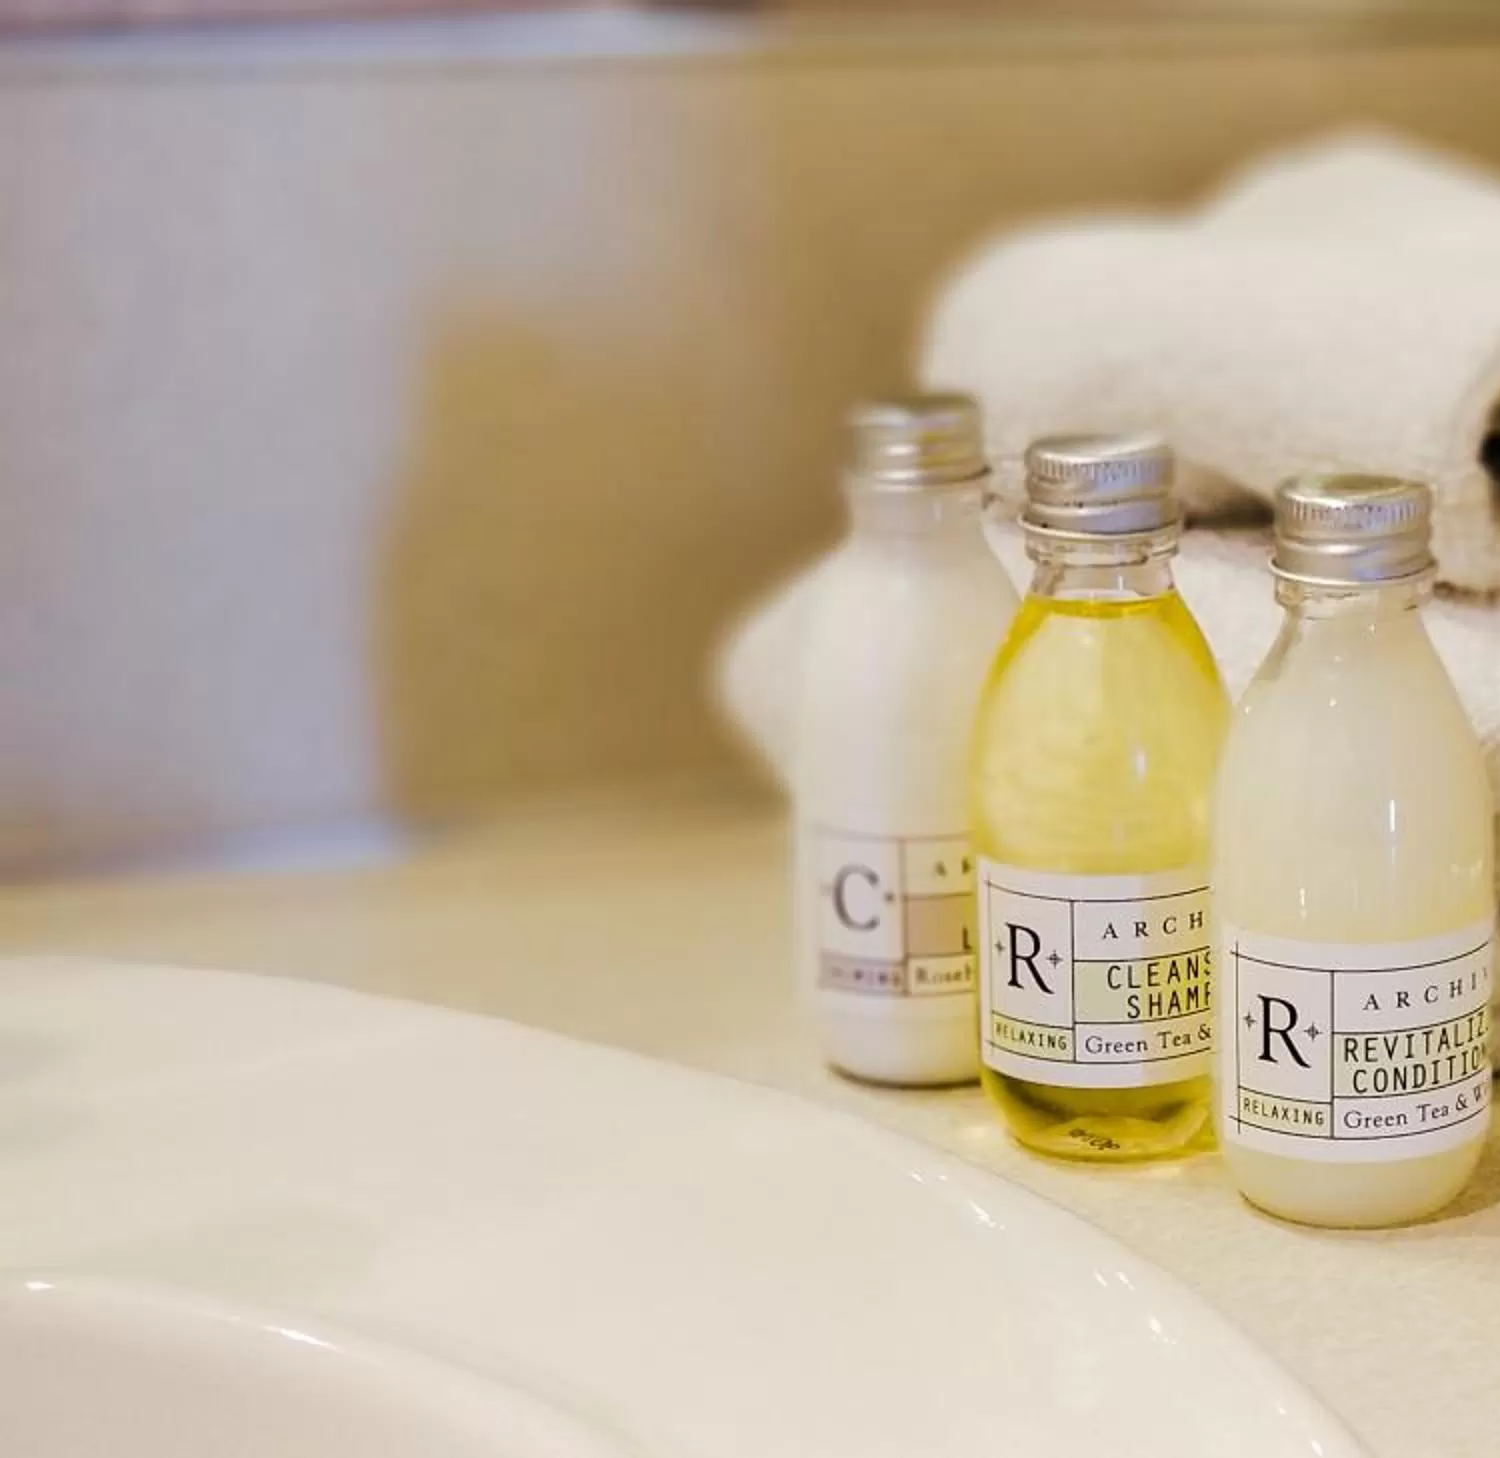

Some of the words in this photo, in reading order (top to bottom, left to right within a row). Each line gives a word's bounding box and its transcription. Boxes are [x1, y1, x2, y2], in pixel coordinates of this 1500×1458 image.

[832, 862, 881, 932] C
[1102, 910, 1204, 940] ARCH
[1004, 921, 1055, 995] R
[995, 1020, 1068, 1051] RELAXING
[1084, 1035, 1149, 1055] Green
[1157, 1030, 1192, 1049] Tea
[1256, 993, 1312, 1070] R
[1343, 1010, 1489, 1063] REVITALIZ
[1352, 1042, 1487, 1095] CONDITIO
[1242, 1096, 1325, 1127] RELAXING
[1343, 1110, 1408, 1129] Green
[1416, 1103, 1450, 1122] Tea
[1455, 1092, 1469, 1111] &
